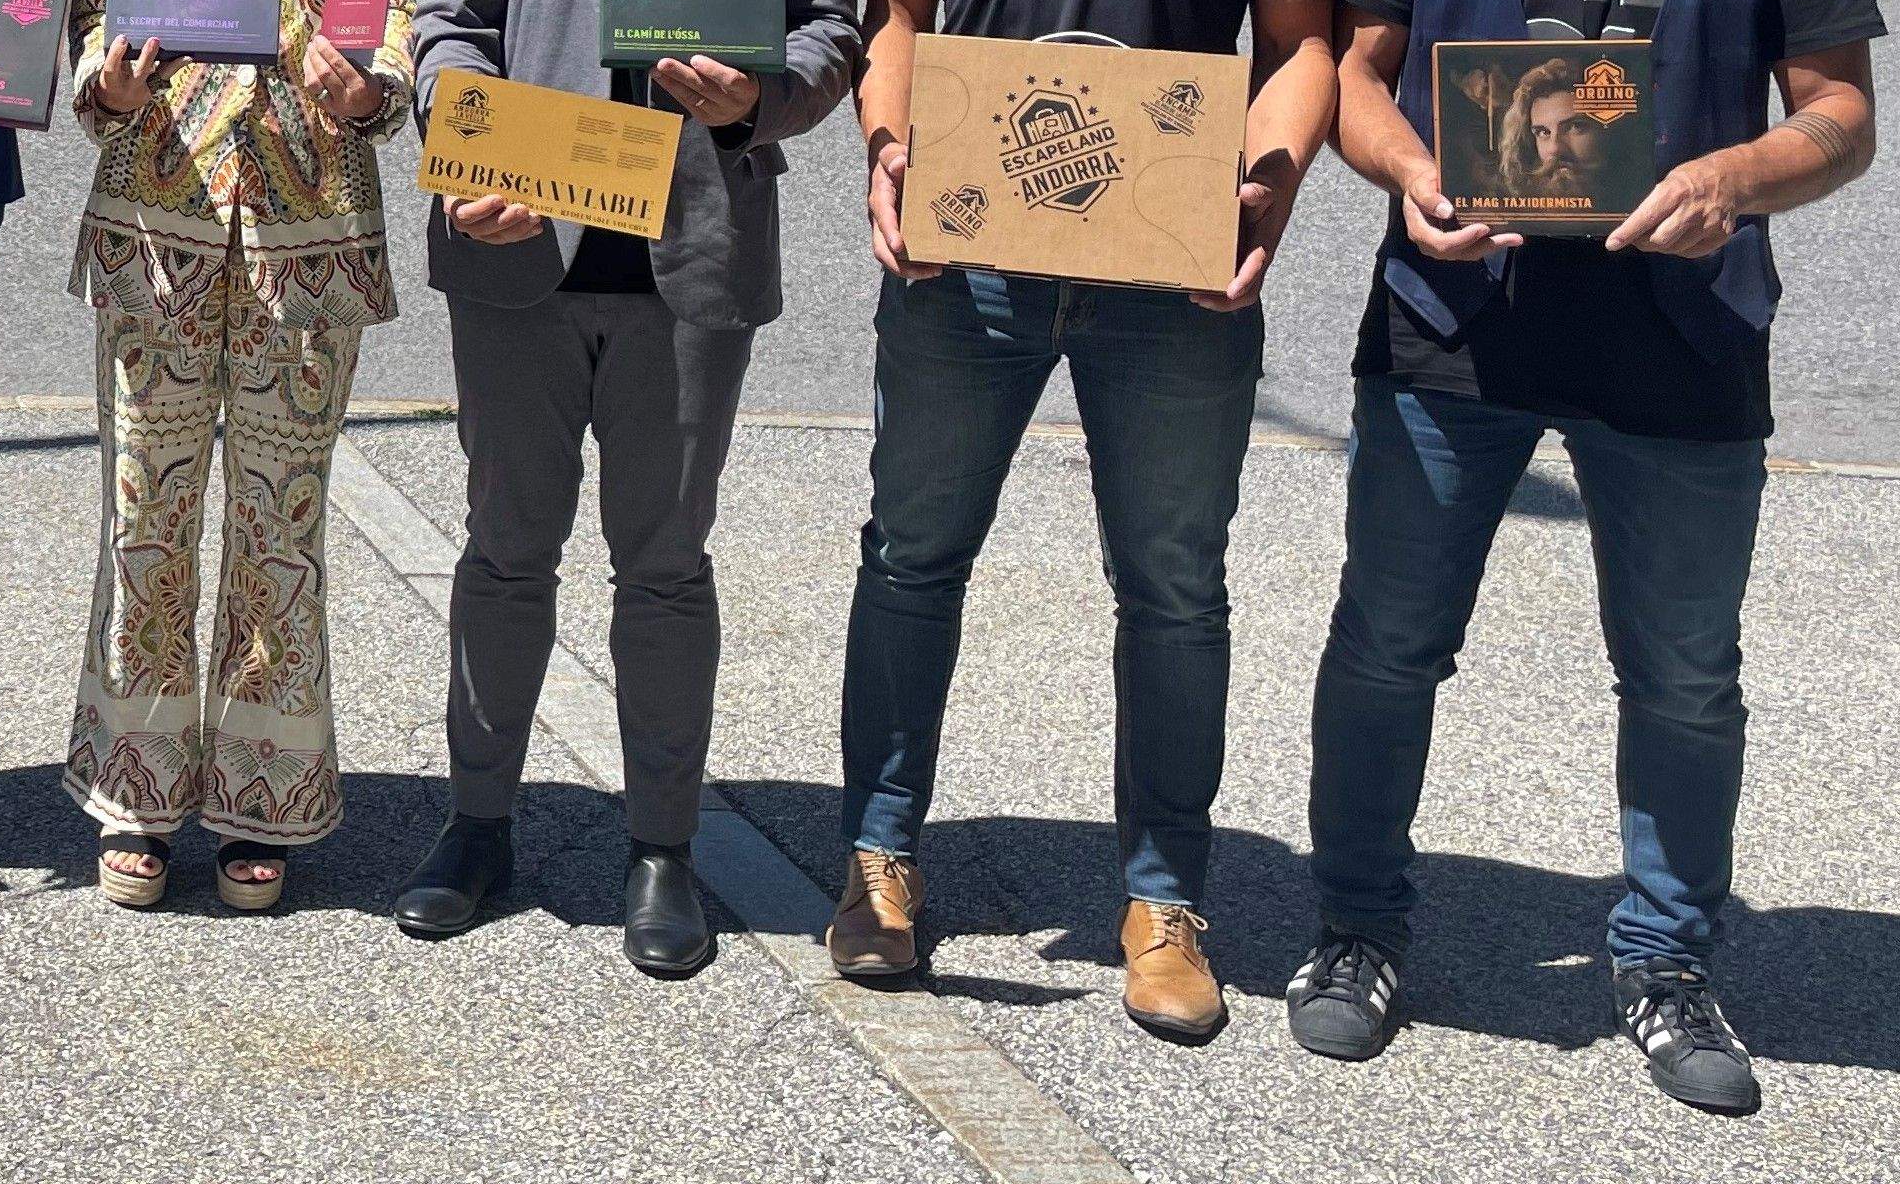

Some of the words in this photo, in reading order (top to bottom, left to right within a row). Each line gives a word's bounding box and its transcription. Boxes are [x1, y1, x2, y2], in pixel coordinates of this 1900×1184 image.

[116, 16, 127, 25] EL
[129, 16, 162, 26] SECRET
[164, 17, 180, 27] DEL
[182, 18, 240, 29] COMERCIANT
[614, 28, 625, 38] EL
[626, 26, 652, 39] CAMÍ
[653, 29, 666, 39] DE
[1575, 87, 1635, 100] ORDINO
[1002, 126, 1116, 173] ESCAPELAND
[428, 155, 464, 180] BO
[1020, 151, 1122, 202] ANDORRA
[940, 193, 983, 230] ORDINO
[1455, 197, 1468, 208] EL
[1472, 197, 1502, 208] MAG
[1503, 197, 1593, 209] TAXIDERMISTA
